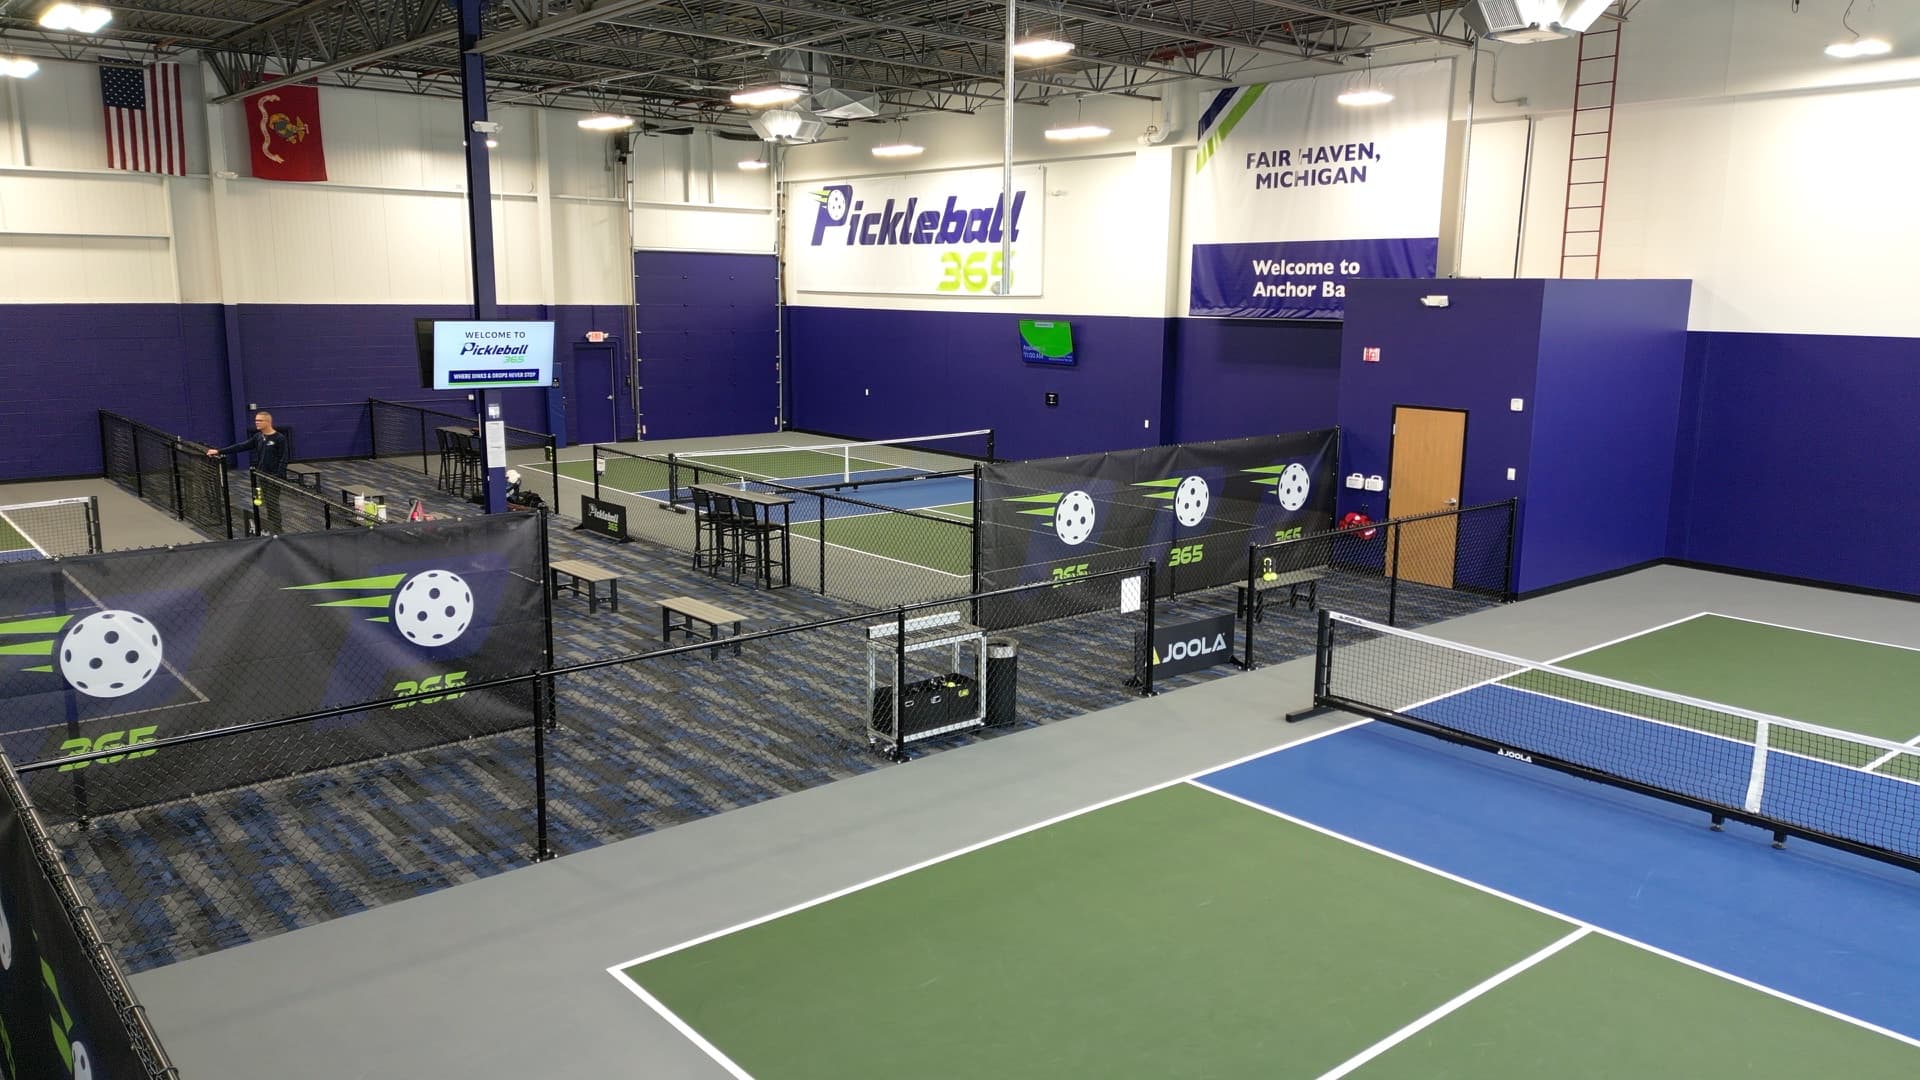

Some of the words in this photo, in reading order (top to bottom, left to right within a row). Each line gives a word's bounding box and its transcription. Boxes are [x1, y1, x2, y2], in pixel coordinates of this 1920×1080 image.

[1246, 149, 1291, 169] FAIR
[1298, 142, 1381, 165] HAVEN,
[1255, 165, 1367, 190] MICHIGAN
[811, 184, 1026, 246] Pickleball
[1252, 259, 1335, 276] Welcome
[1340, 259, 1360, 275] to
[1252, 281, 1317, 297] Anchor
[1322, 281, 1346, 298] Ba
[465, 331, 511, 339] WELCOME
[515, 331, 526, 339] TO
[460, 342, 529, 355] Pickleball
[503, 355, 525, 364] 365
[1168, 544, 1204, 566] 365
[1162, 633, 1227, 663] JOOLA
[1503, 750, 1532, 763] JOOLA
